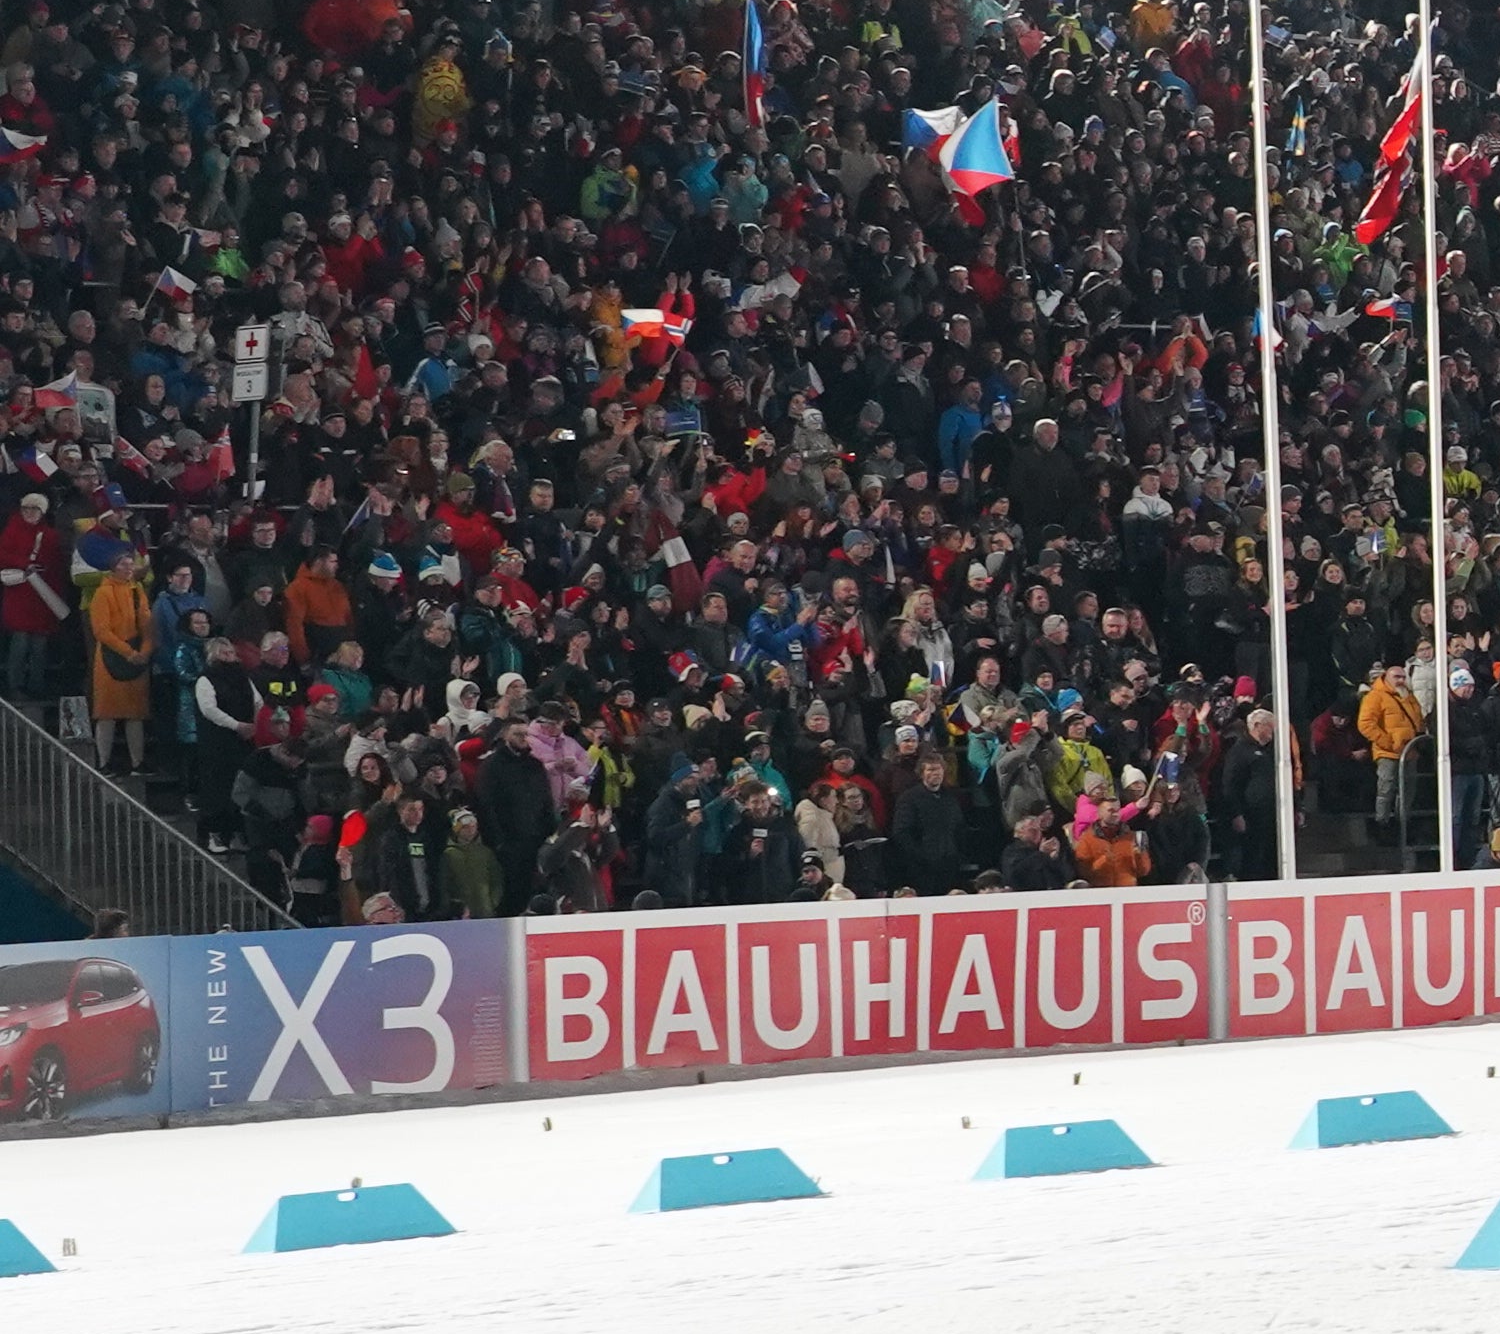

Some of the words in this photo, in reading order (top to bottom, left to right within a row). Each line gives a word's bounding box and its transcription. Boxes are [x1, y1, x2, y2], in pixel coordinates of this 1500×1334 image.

[207, 948, 228, 1025] NEW
[240, 933, 456, 1102] X3
[545, 923, 1199, 1062] BAUHAUS
